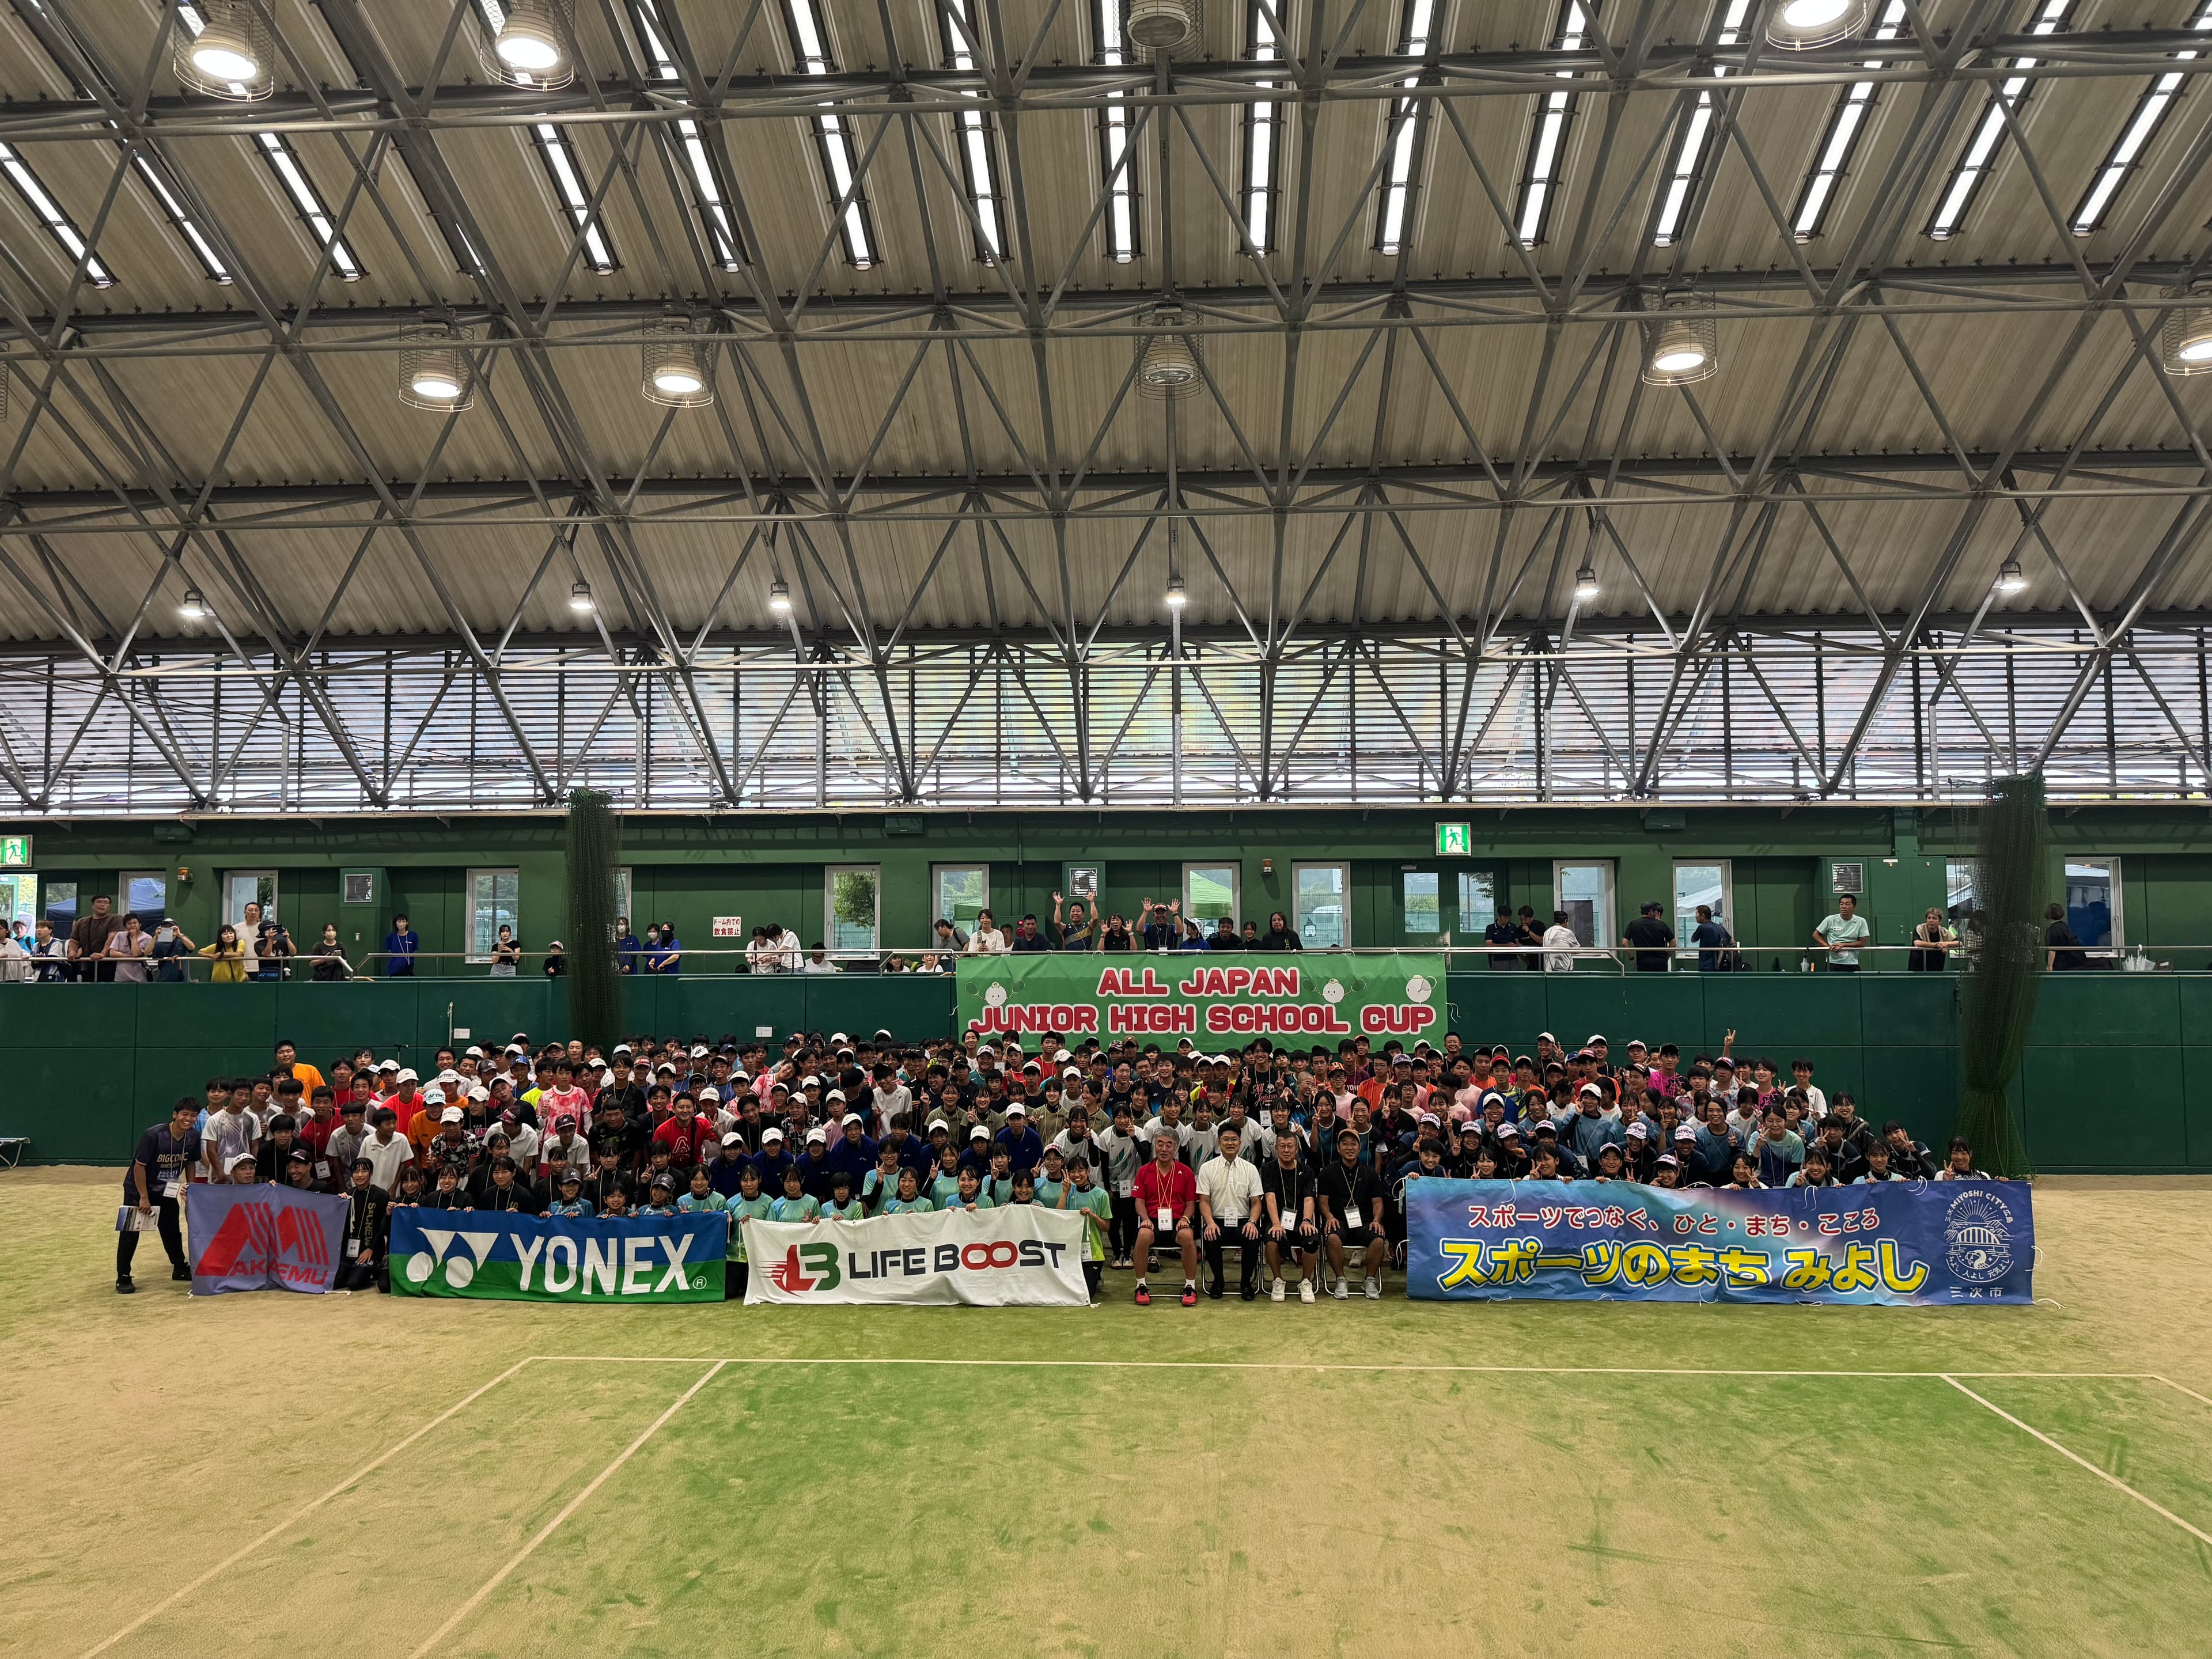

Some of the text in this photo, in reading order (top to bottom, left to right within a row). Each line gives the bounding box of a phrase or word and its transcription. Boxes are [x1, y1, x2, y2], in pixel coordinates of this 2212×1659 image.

[714, 927, 740, 935] 飲食禁止
[1097, 967, 1300, 997] ALL JAPAN
[968, 1004, 1436, 1035] JUNIOR HIGH SCHOOL CUP
[1950, 1190, 2008, 1210] MIYOSHI CITY
[510, 1233, 695, 1295] YONEX
[849, 1248, 926, 1279] LIFE
[934, 1240, 1066, 1272] BOOST
[1781, 1238, 1930, 1295] みよし
[1949, 1286, 2003, 1298] 三次市
